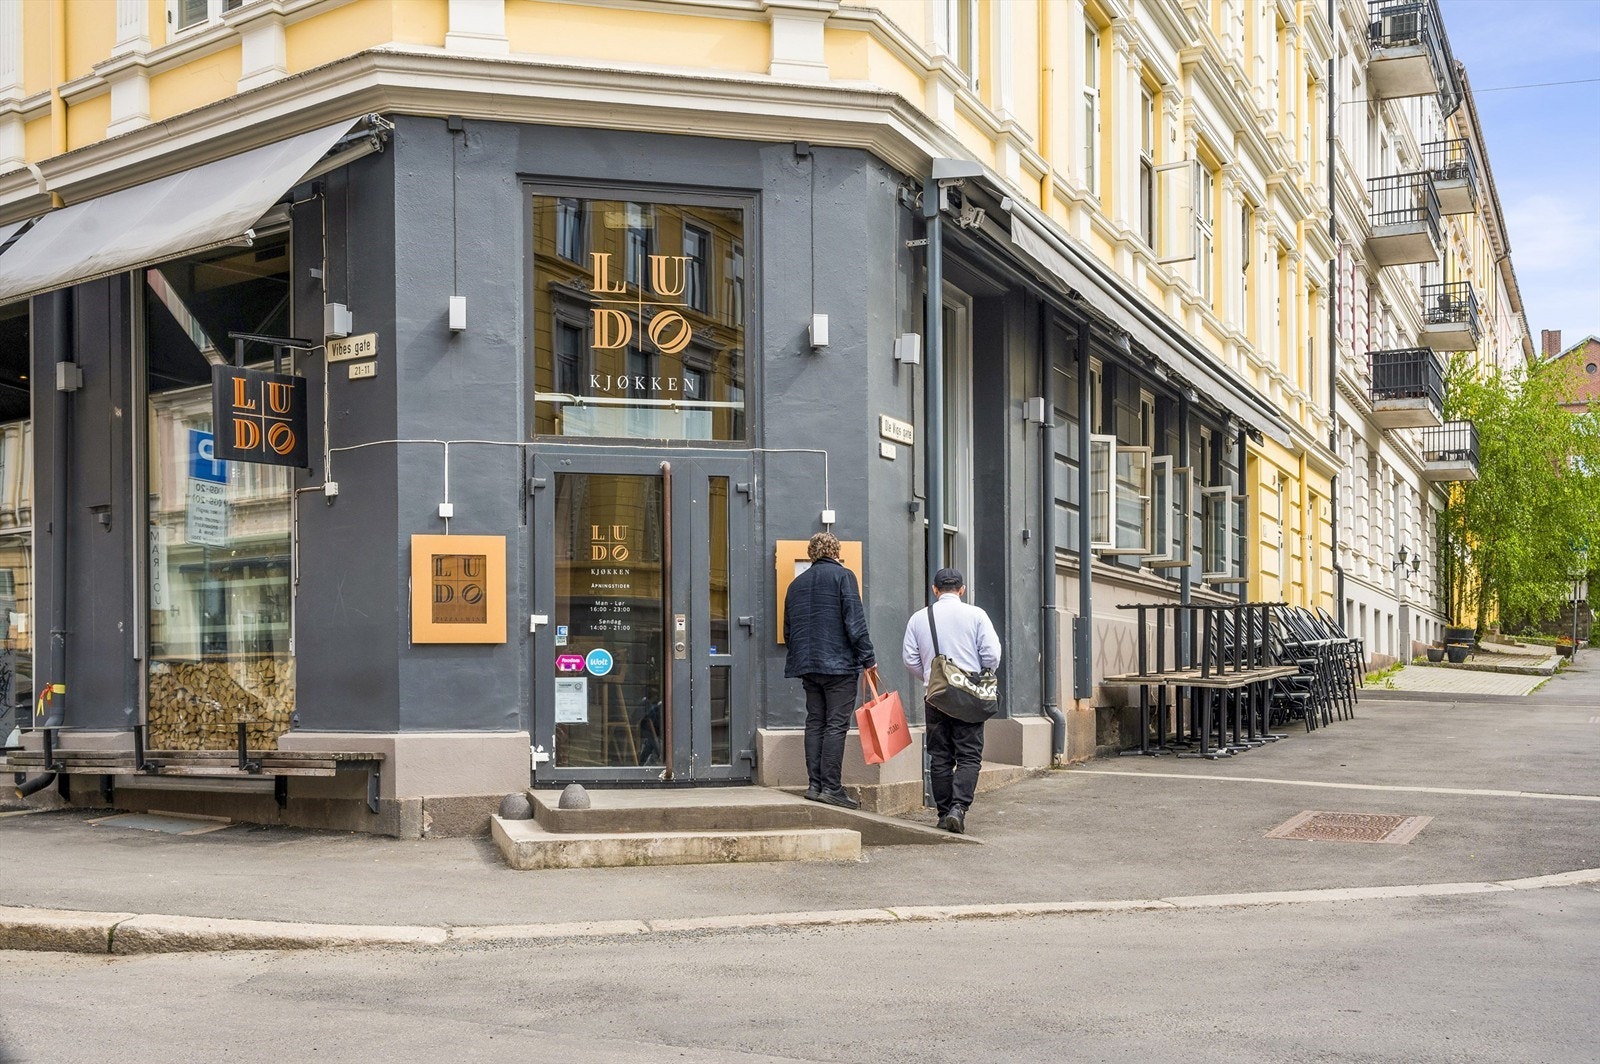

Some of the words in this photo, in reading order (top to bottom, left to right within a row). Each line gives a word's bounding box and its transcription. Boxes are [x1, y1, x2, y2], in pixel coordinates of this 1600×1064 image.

[331, 342, 352, 357] Vibes
[354, 339, 371, 356] gate
[354, 365, 370, 376] 21-11
[590, 374, 695, 392] KJØKKEN
[590, 568, 630, 576] KJØKKEN
[590, 658, 609, 666] Wolt
